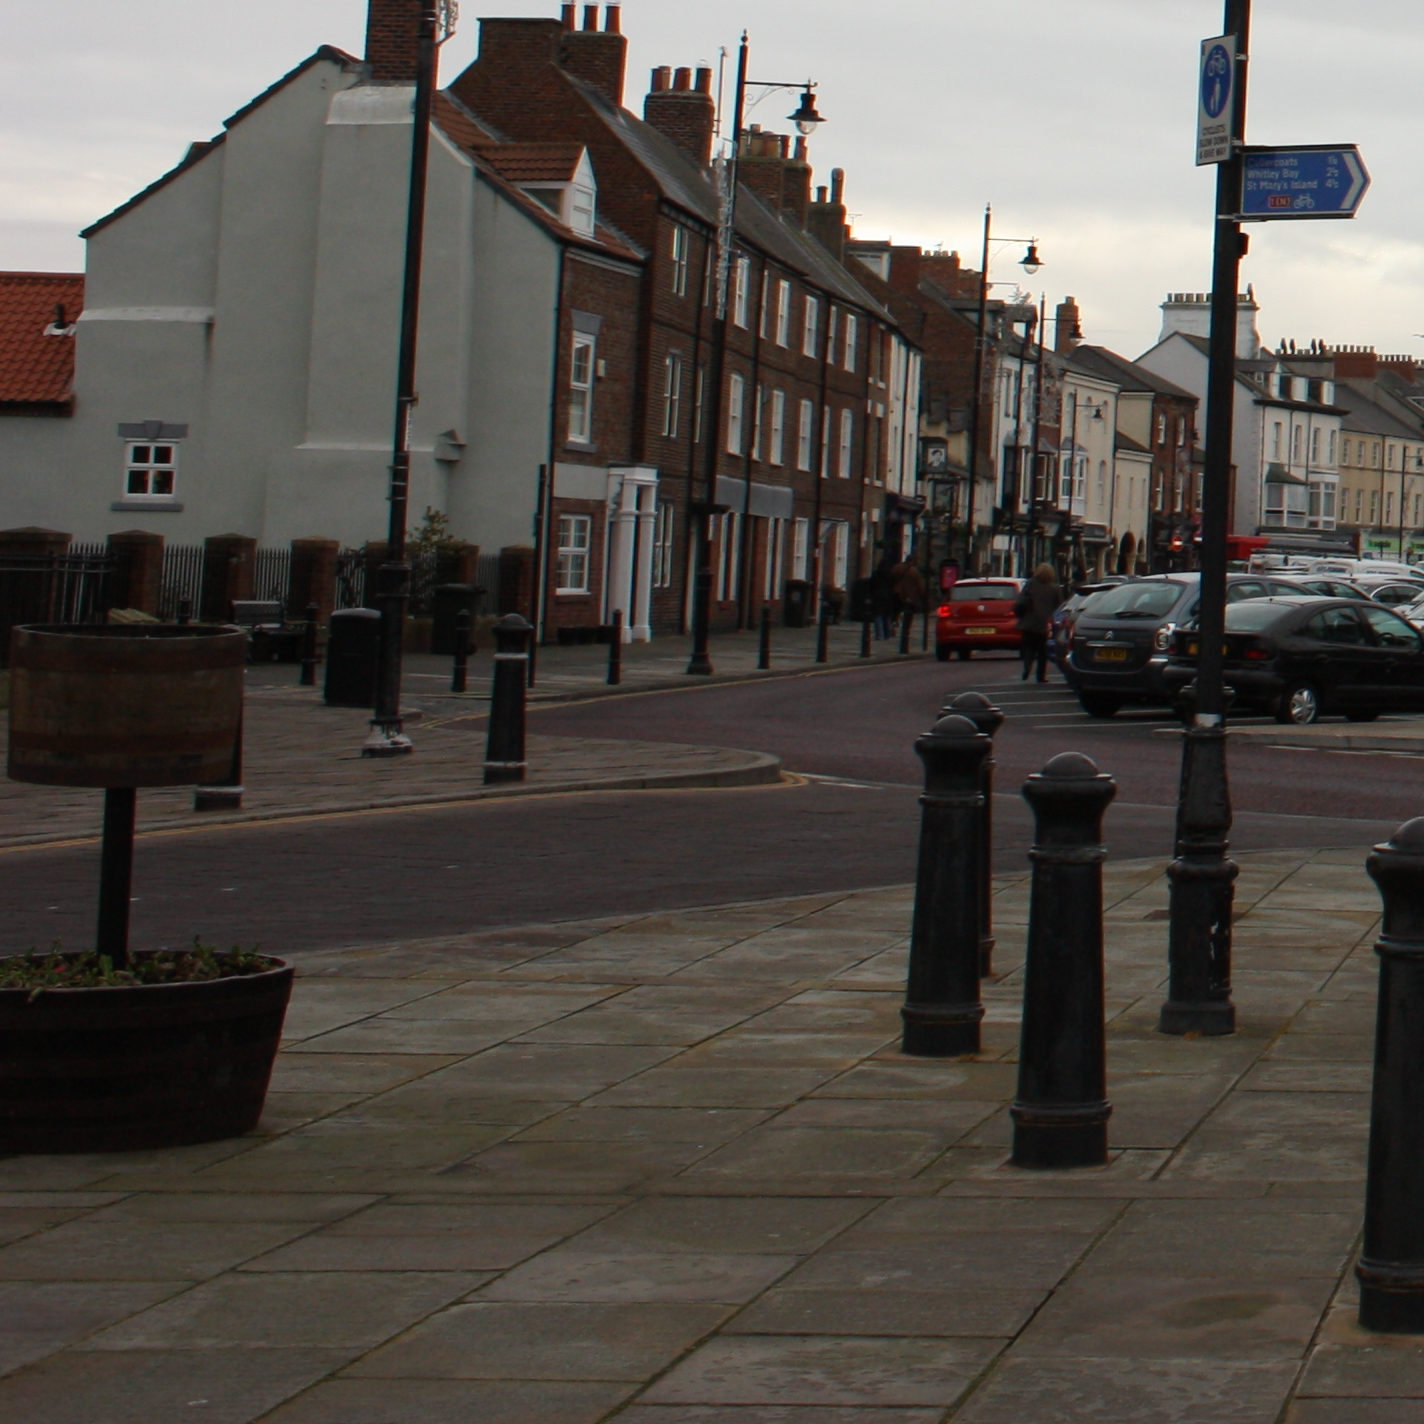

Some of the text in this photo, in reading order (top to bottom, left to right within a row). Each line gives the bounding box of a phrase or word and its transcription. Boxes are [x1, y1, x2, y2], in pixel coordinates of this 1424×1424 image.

[1247, 169, 1280, 180] Whitley
[1282, 168, 1299, 179] Bay
[1247, 181, 1257, 190] St
[1259, 180, 1288, 191] Mary's
[1291, 179, 1318, 189] Island
